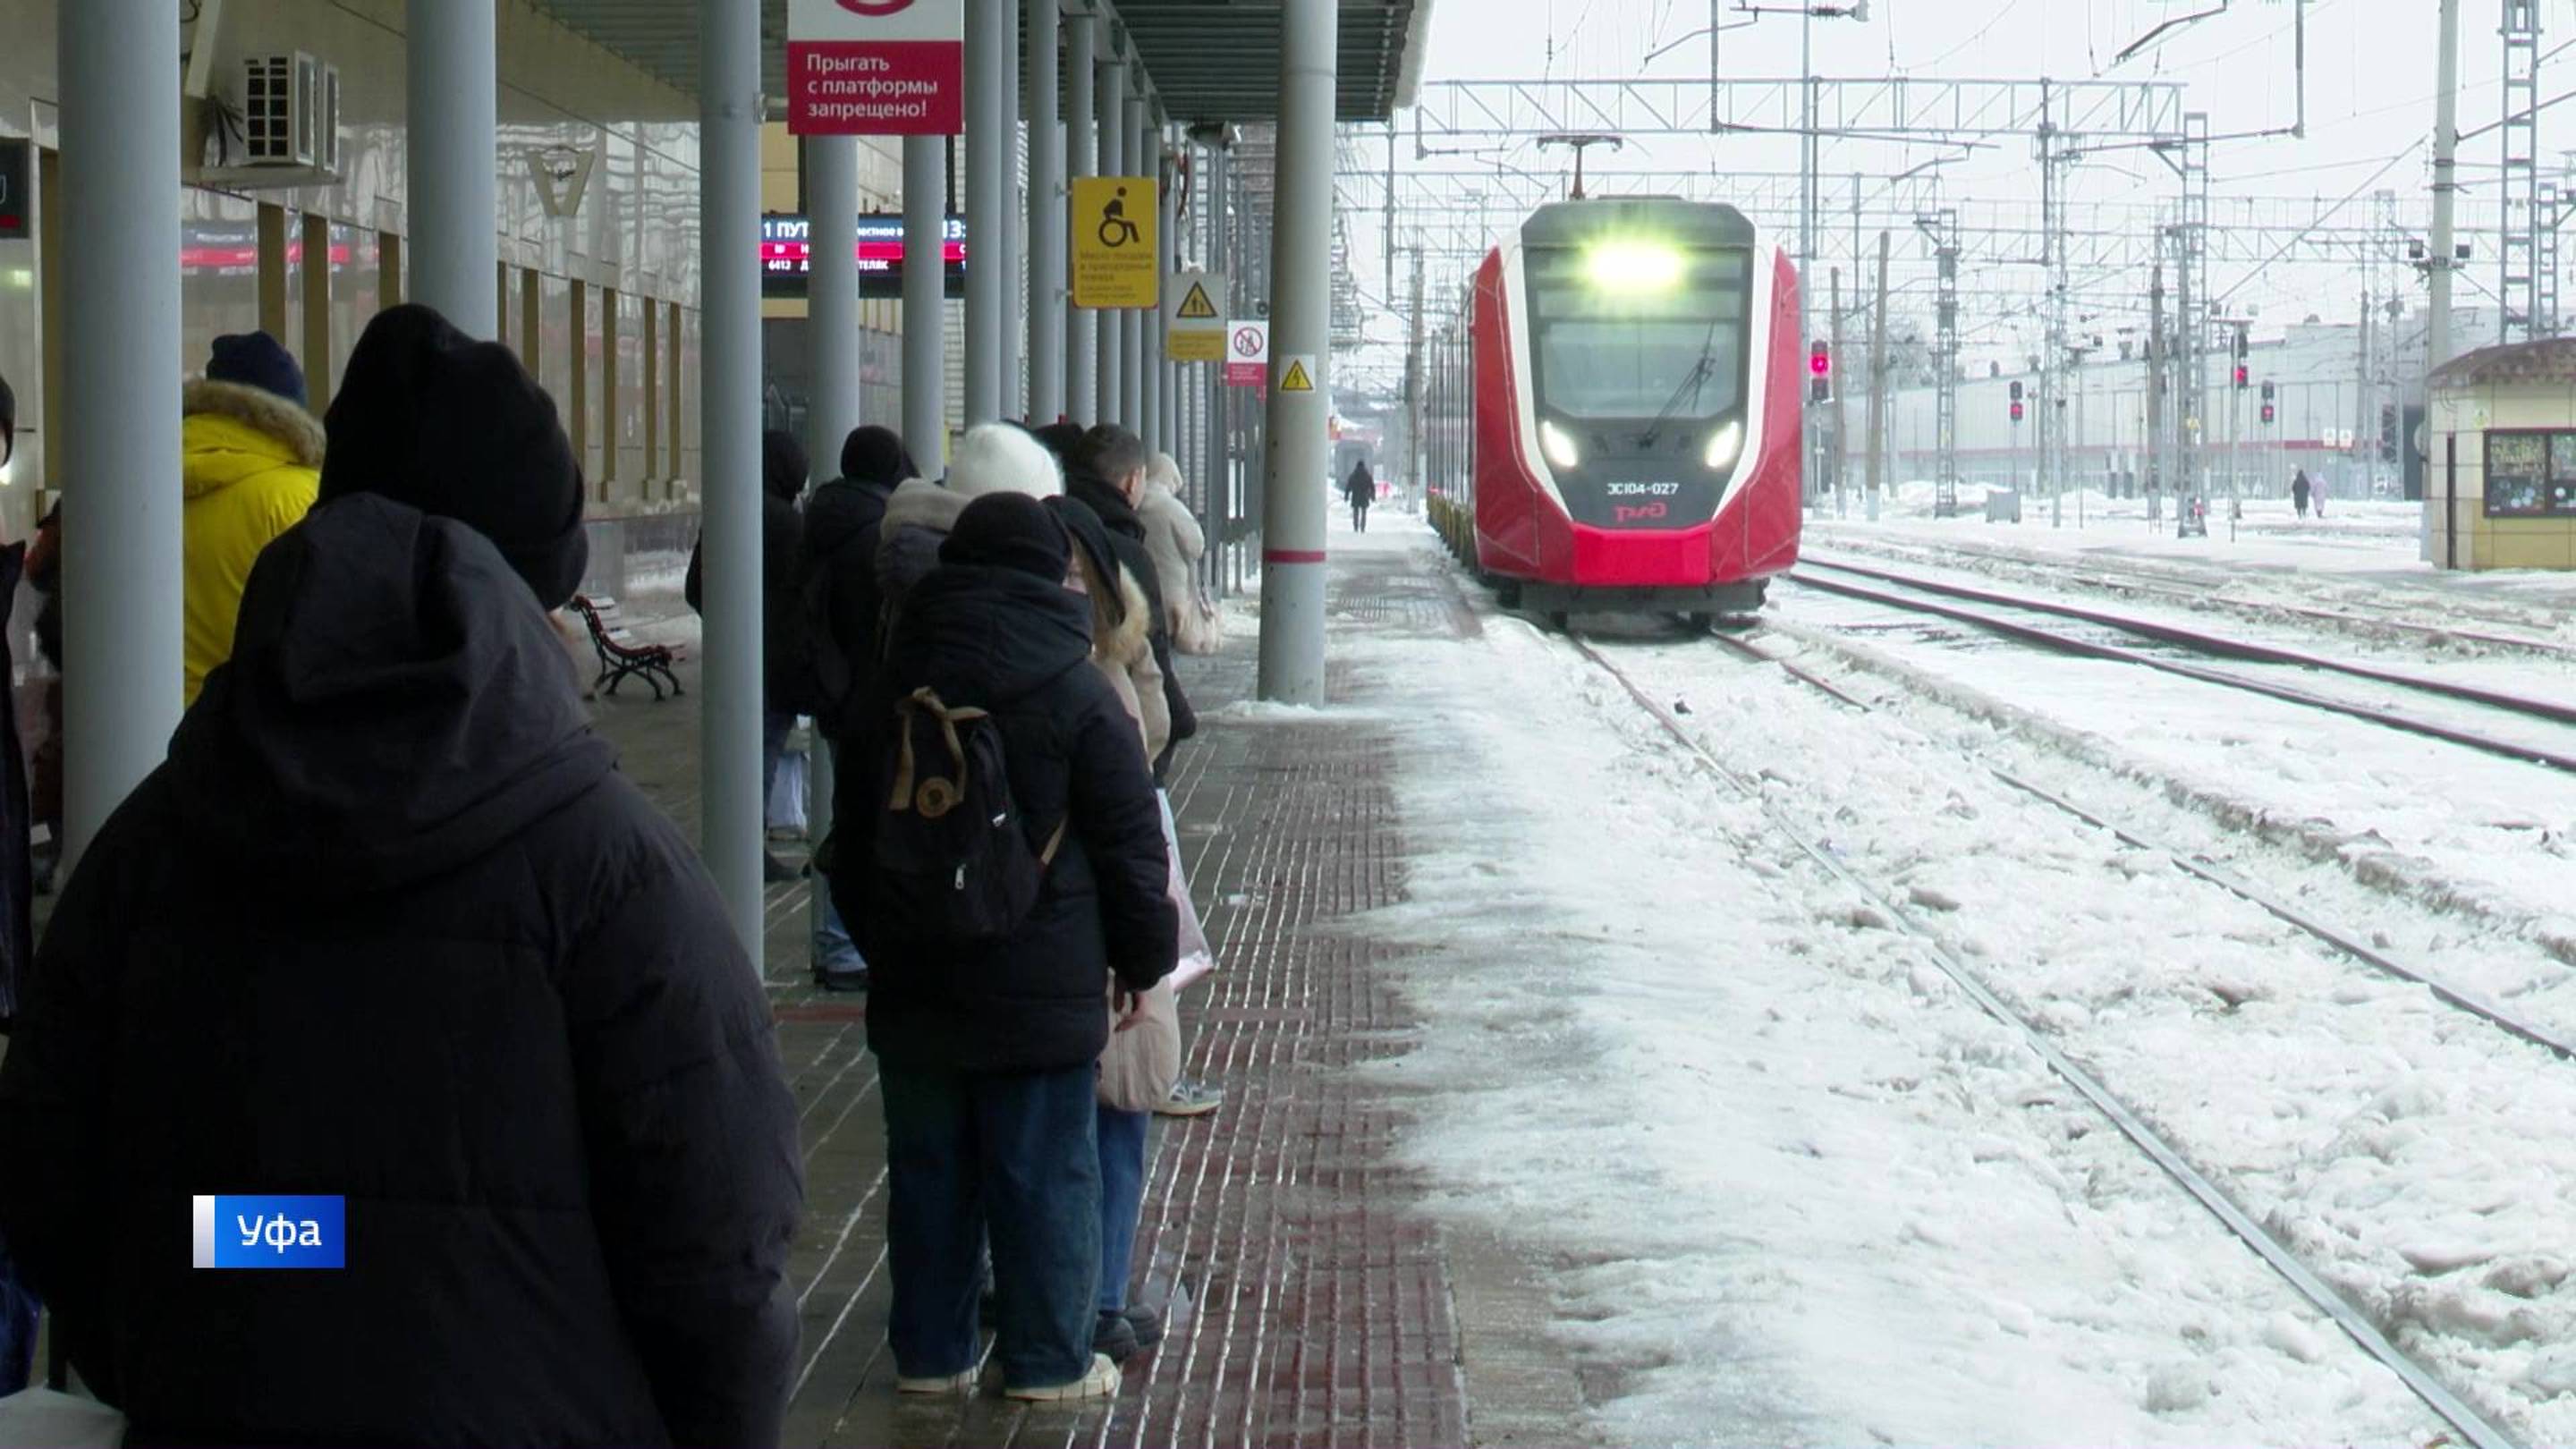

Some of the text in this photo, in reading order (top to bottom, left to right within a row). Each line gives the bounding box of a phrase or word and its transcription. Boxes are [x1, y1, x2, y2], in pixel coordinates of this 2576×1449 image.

[807, 54, 890, 74] Прыгать
[808, 78, 937, 97] с платформы
[808, 101, 927, 120] запрещено!
[764, 222, 771, 238] 1
[777, 222, 809, 238] ПУТ
